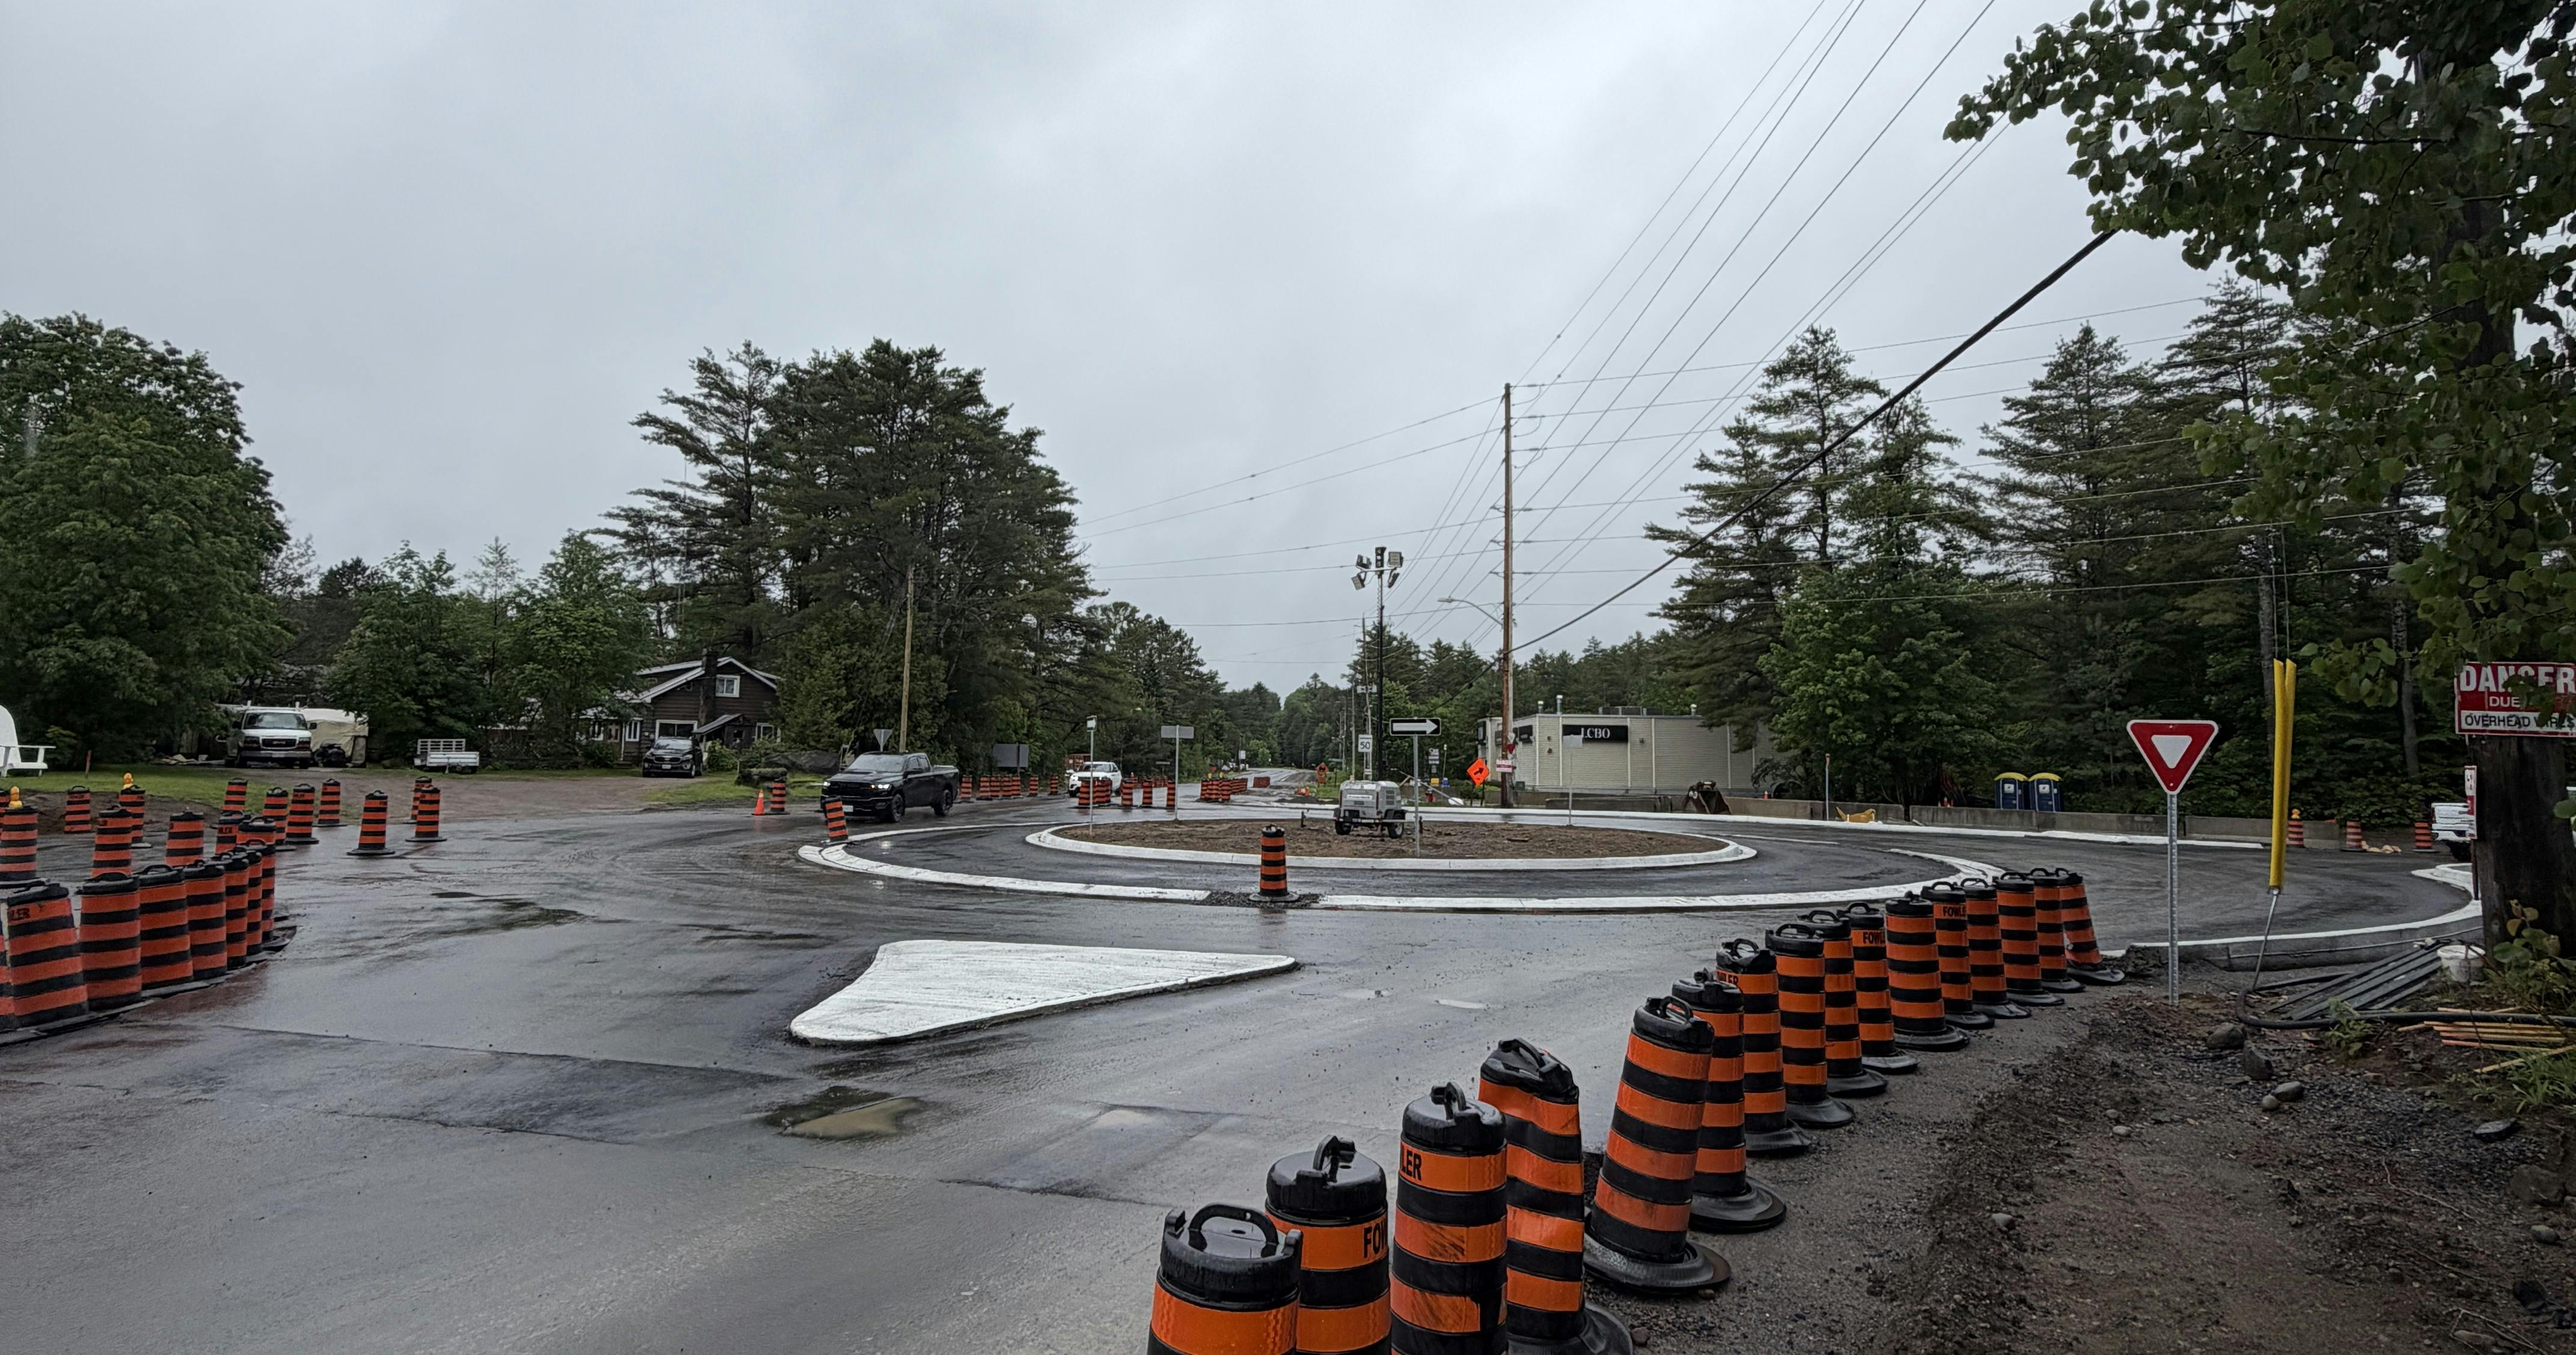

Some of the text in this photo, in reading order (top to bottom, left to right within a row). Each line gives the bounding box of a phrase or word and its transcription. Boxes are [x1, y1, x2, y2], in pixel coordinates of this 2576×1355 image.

[2489, 696, 2520, 708] DUE
[2465, 714, 2530, 728] OVERHEAD
[1581, 727, 1610, 739] LCBO
[1360, 741, 1370, 750] 50
